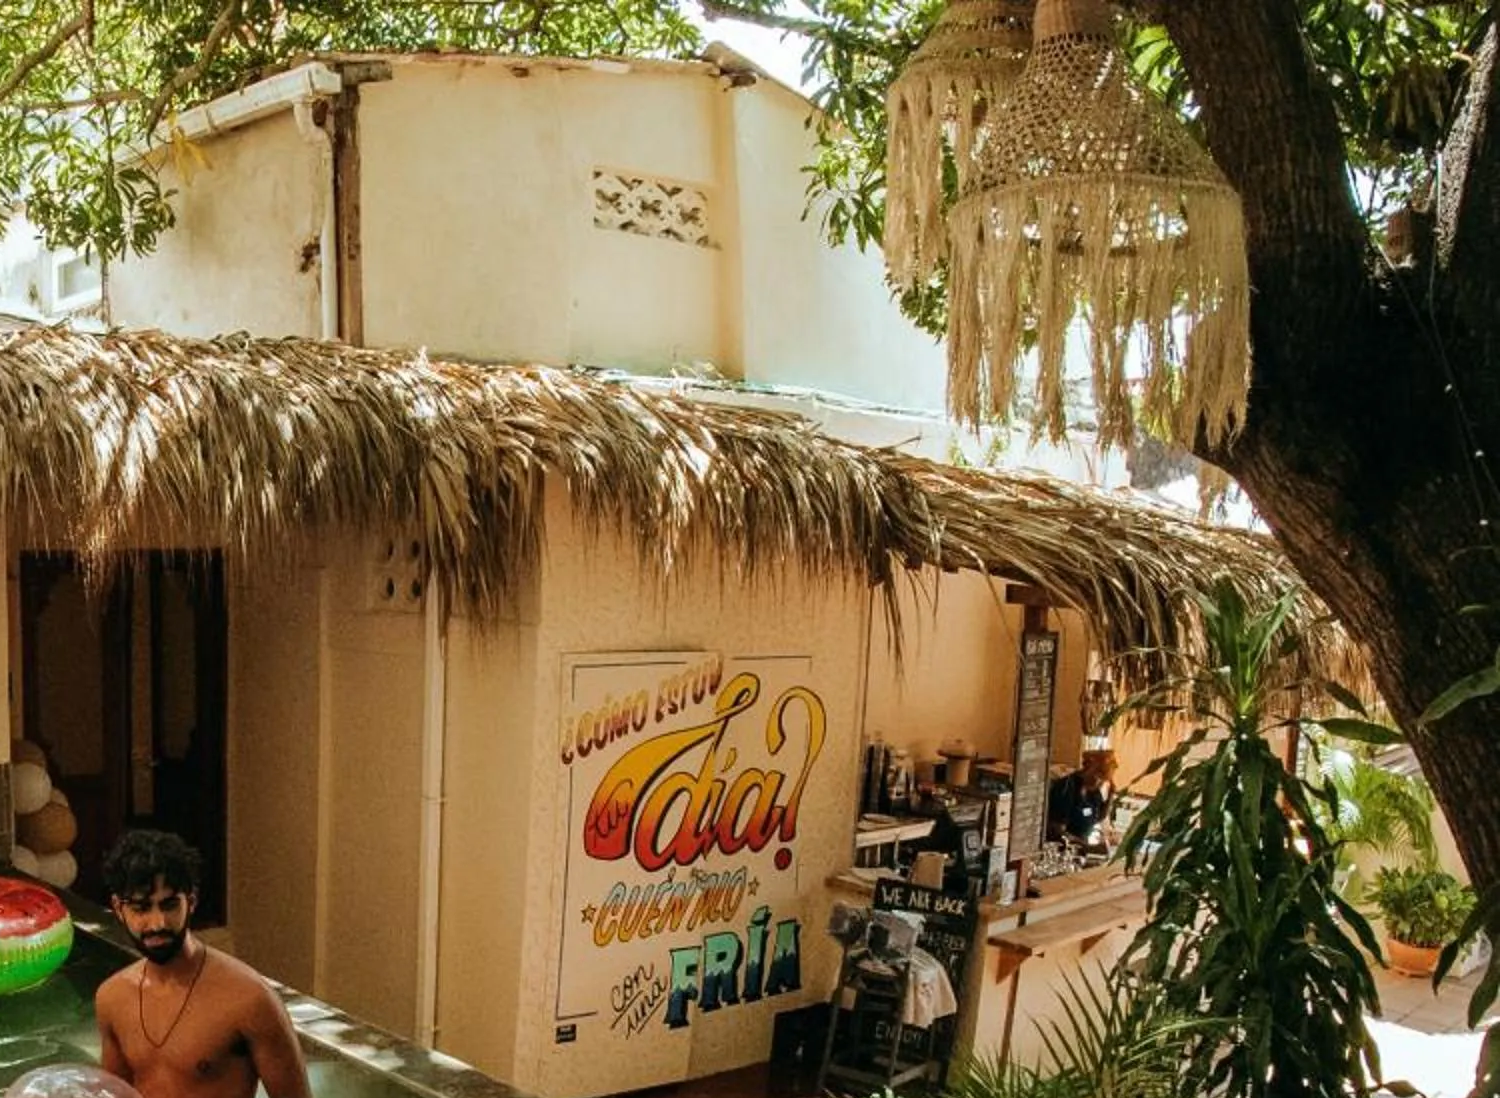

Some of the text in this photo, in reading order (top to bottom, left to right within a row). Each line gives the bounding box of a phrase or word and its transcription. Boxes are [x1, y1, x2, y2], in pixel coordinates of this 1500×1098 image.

[881, 885, 906, 906] WE
[935, 895, 966, 917] BACK
[610, 963, 670, 1040] con una
[663, 905, 803, 1030] FRÍA
